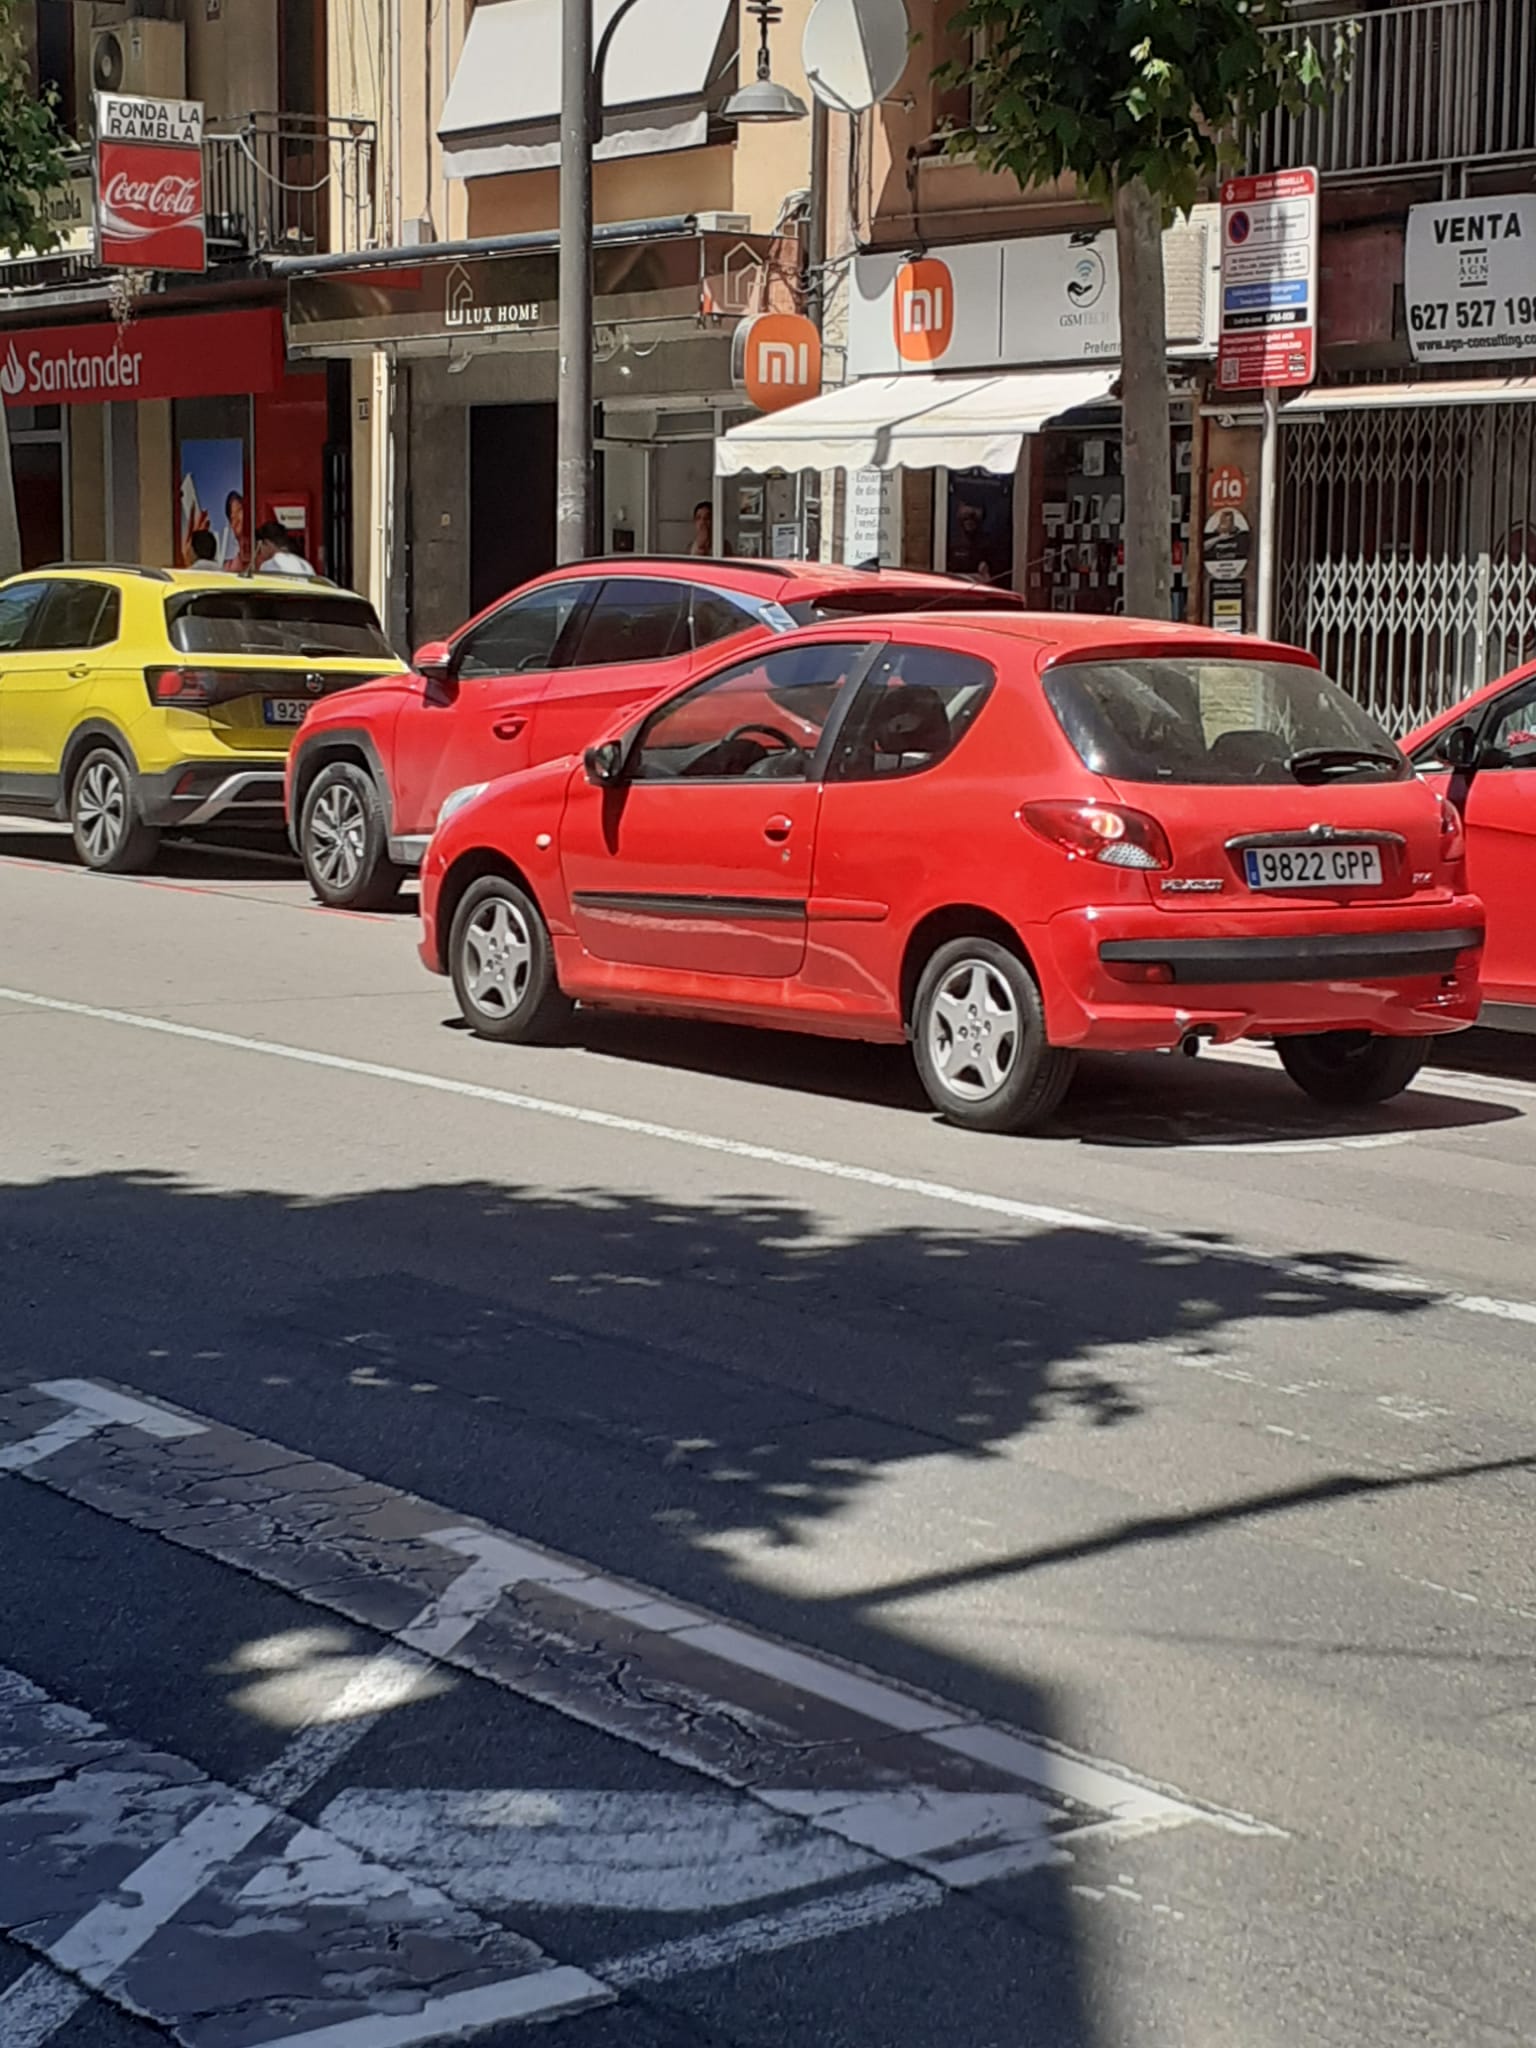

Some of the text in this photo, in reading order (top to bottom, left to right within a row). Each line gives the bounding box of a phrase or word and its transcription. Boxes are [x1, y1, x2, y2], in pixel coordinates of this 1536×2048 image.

[107, 101, 200, 124] FONDA LA
[111, 120, 195, 141] RAMBLA
[105, 172, 200, 215] Coca-Cola
[1433, 212, 1521, 244] VENTA
[1458, 264, 1489, 276] AGN
[466, 303, 539, 324] LUX HOME
[1410, 301, 1449, 331] 627
[1456, 299, 1496, 328] 527
[28, 350, 142, 393] Santander
[1212, 470, 1242, 498] ria
[1263, 851, 1374, 882] 9822 GPP
